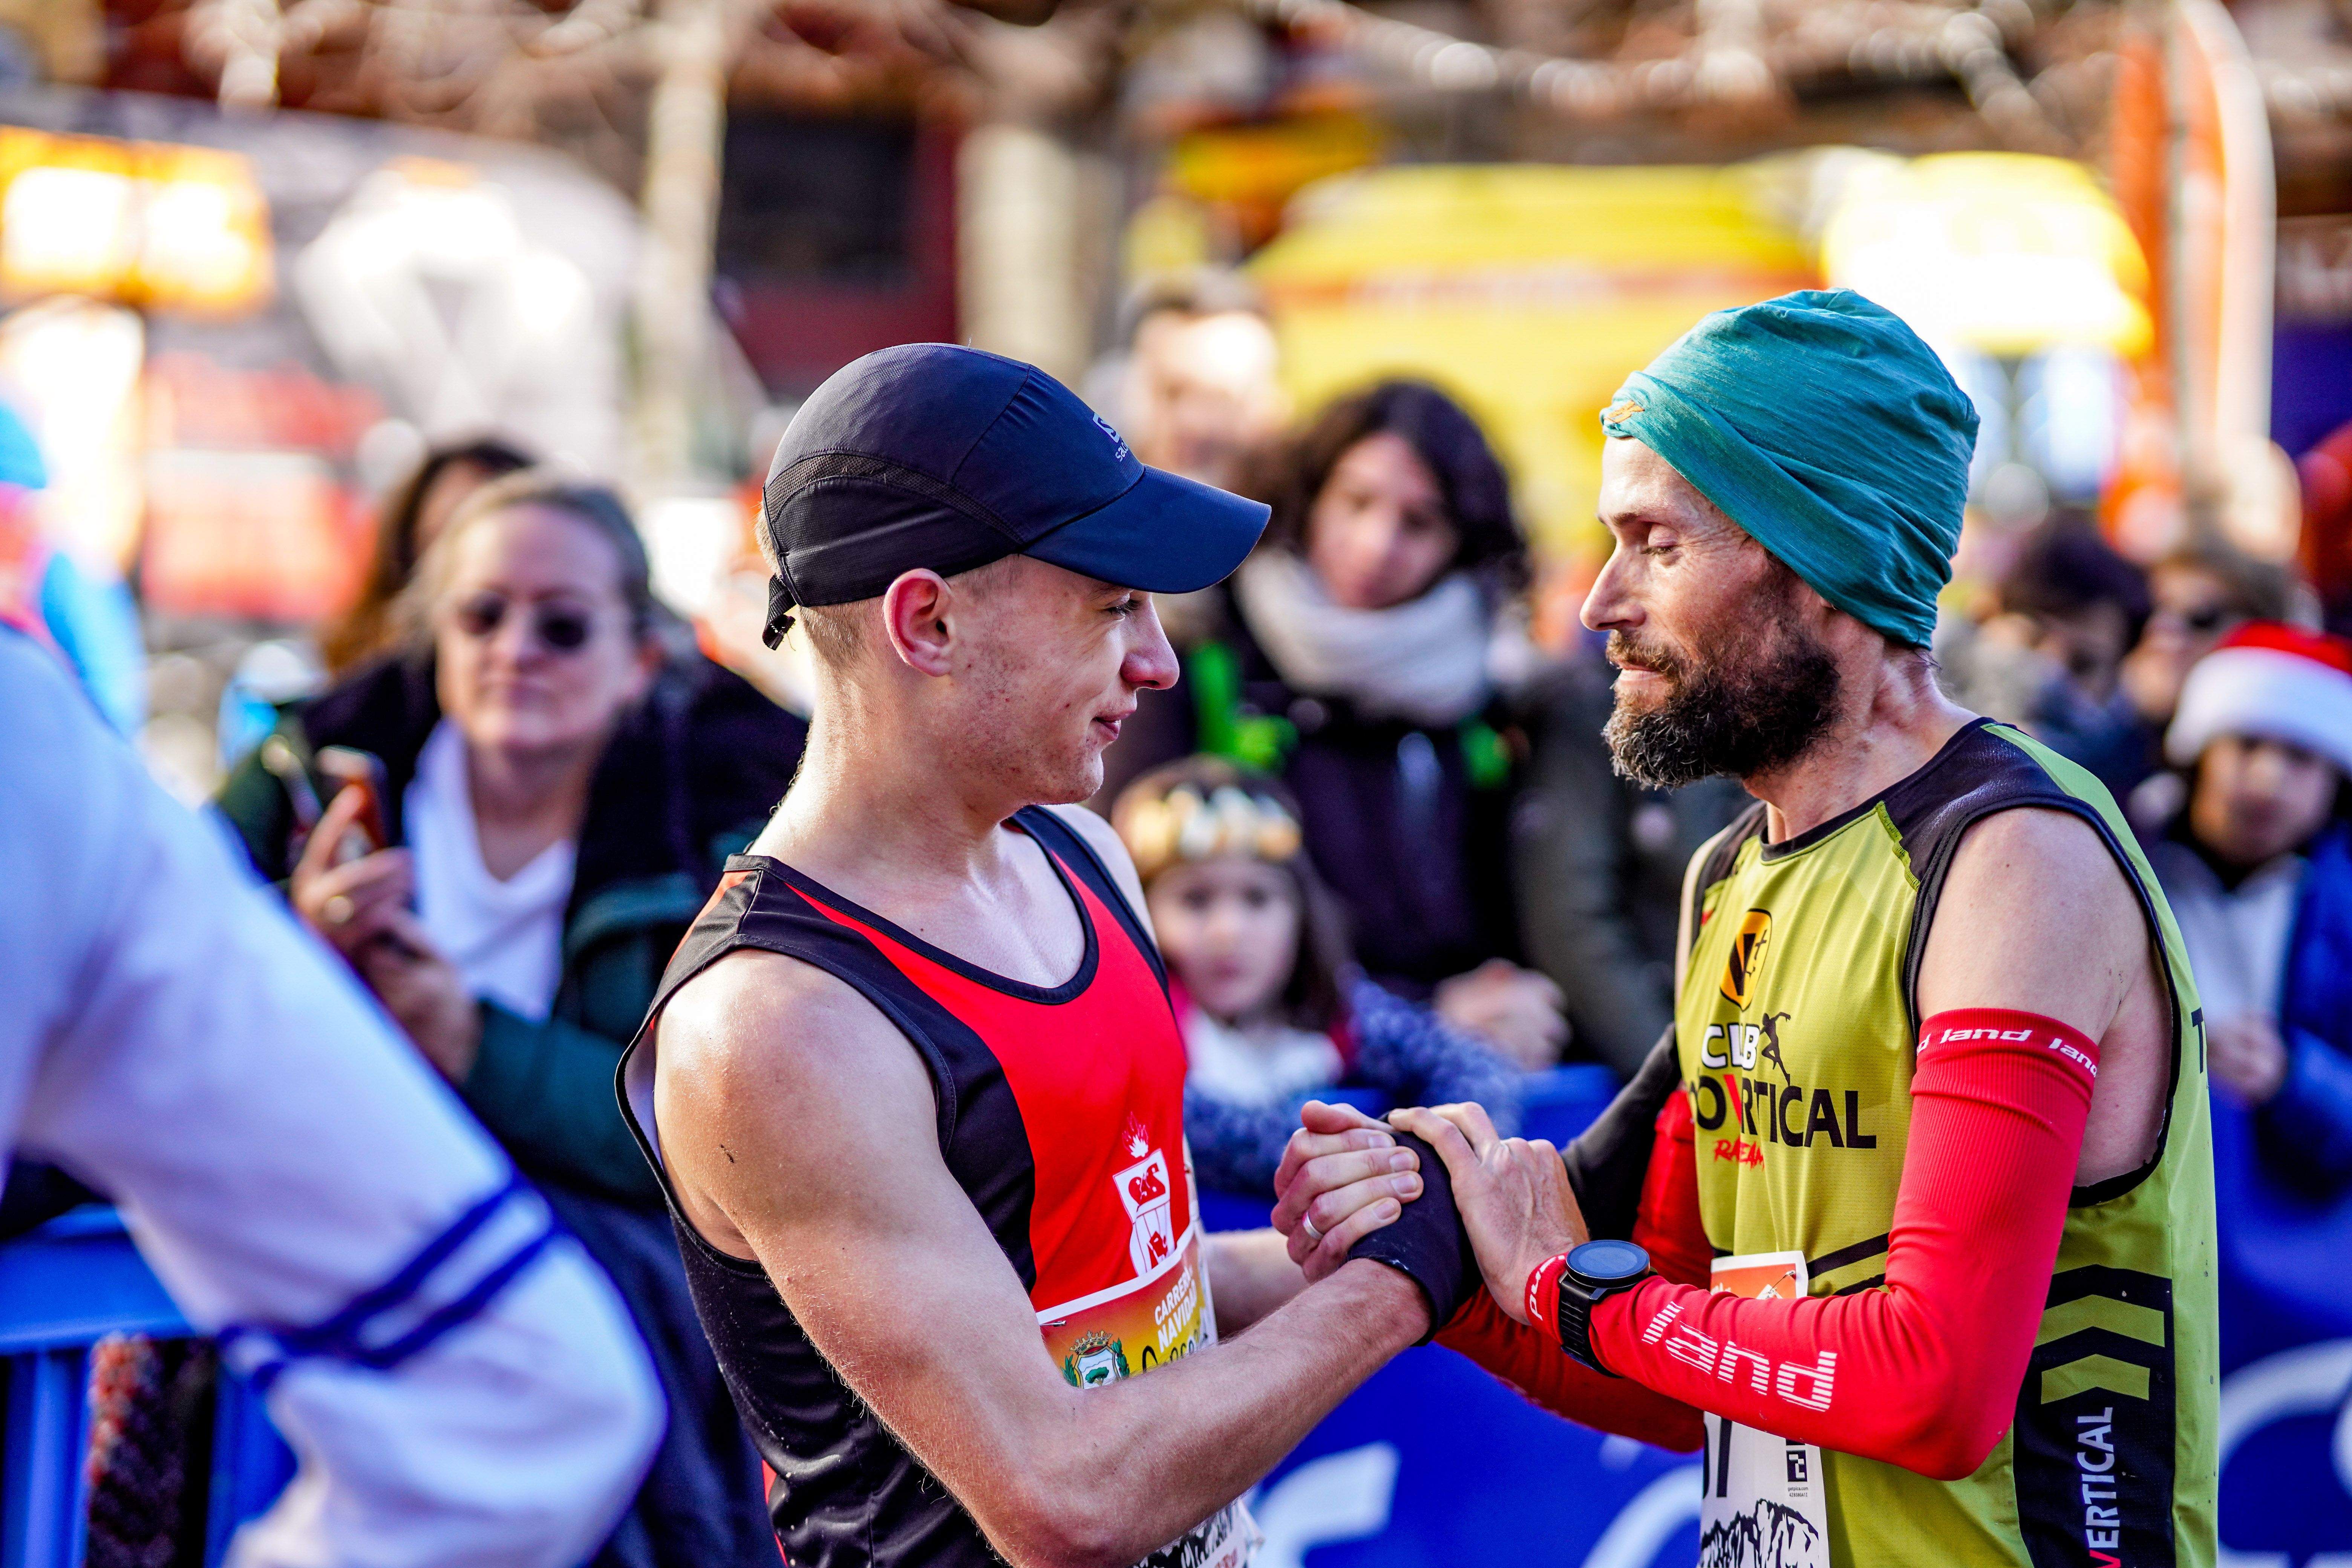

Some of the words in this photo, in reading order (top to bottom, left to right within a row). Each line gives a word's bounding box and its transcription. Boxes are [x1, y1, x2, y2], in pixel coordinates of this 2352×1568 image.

[1701, 1021, 1760, 1071] CLB
[1940, 1029, 2033, 1043] land
[1154, 1266, 1193, 1325] CARRE
[1157, 1279, 1197, 1353] NAVID
[1641, 1301, 1838, 1412] land
